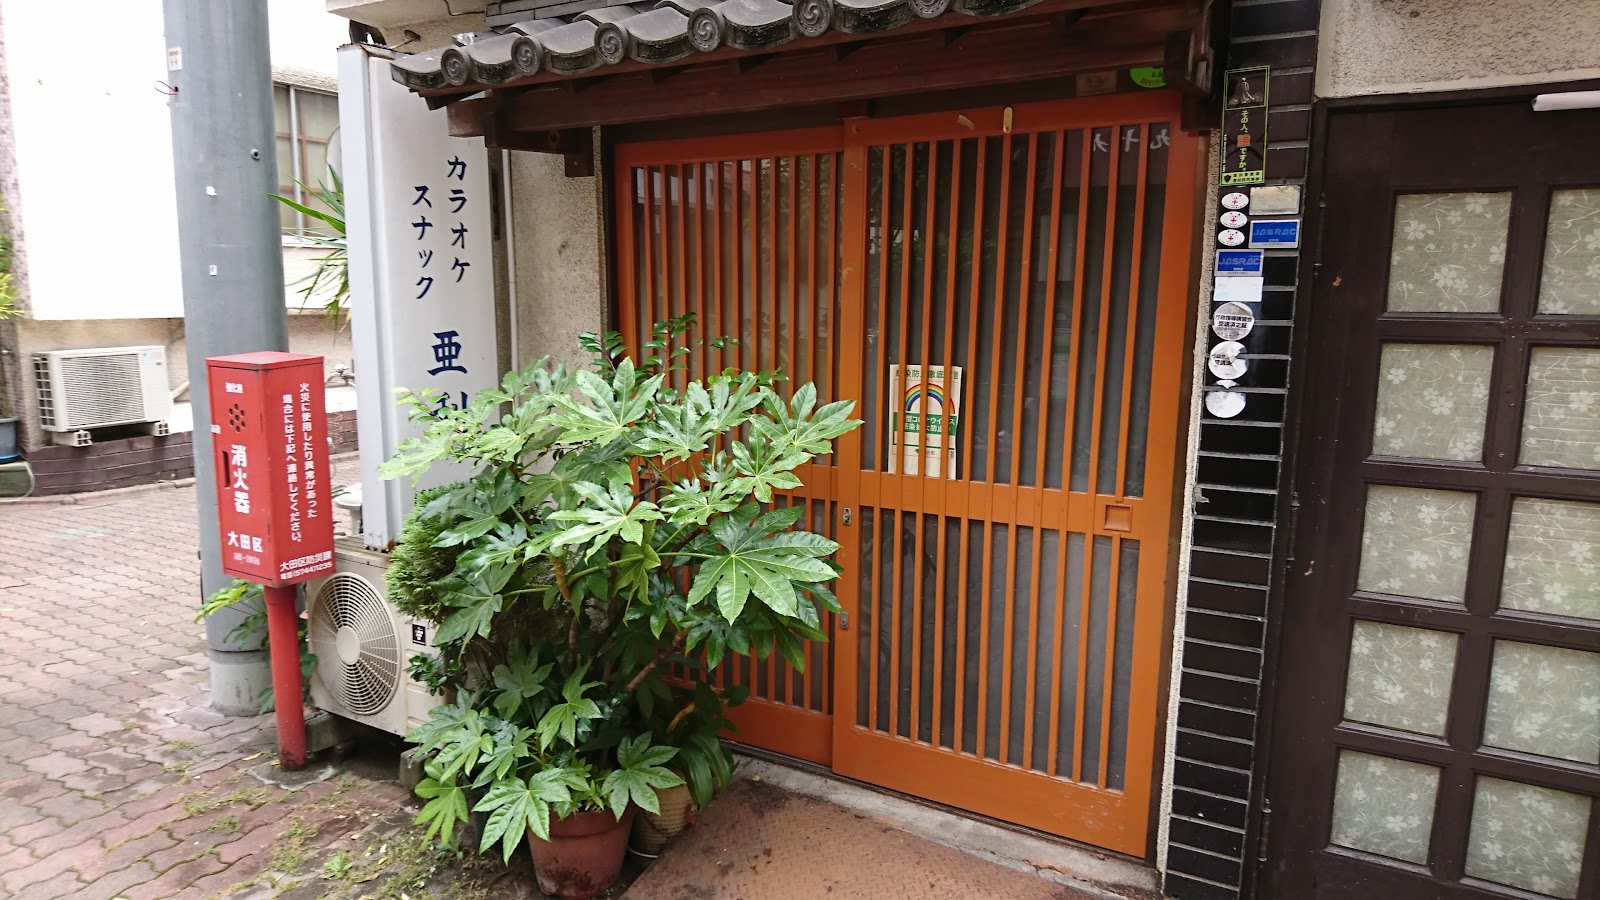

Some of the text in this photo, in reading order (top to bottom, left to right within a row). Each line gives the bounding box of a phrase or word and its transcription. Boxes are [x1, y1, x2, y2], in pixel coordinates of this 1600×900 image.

[411, 185, 434, 300] スナック
[447, 155, 471, 283] カラオケ
[1253, 228, 1297, 236] JASRAC
[1217, 257, 1261, 266] JASRAC
[231, 443, 251, 514] 消火器
[300, 382, 317, 518] 火災に使用したり異常があった
[227, 530, 263, 553] 大田区
